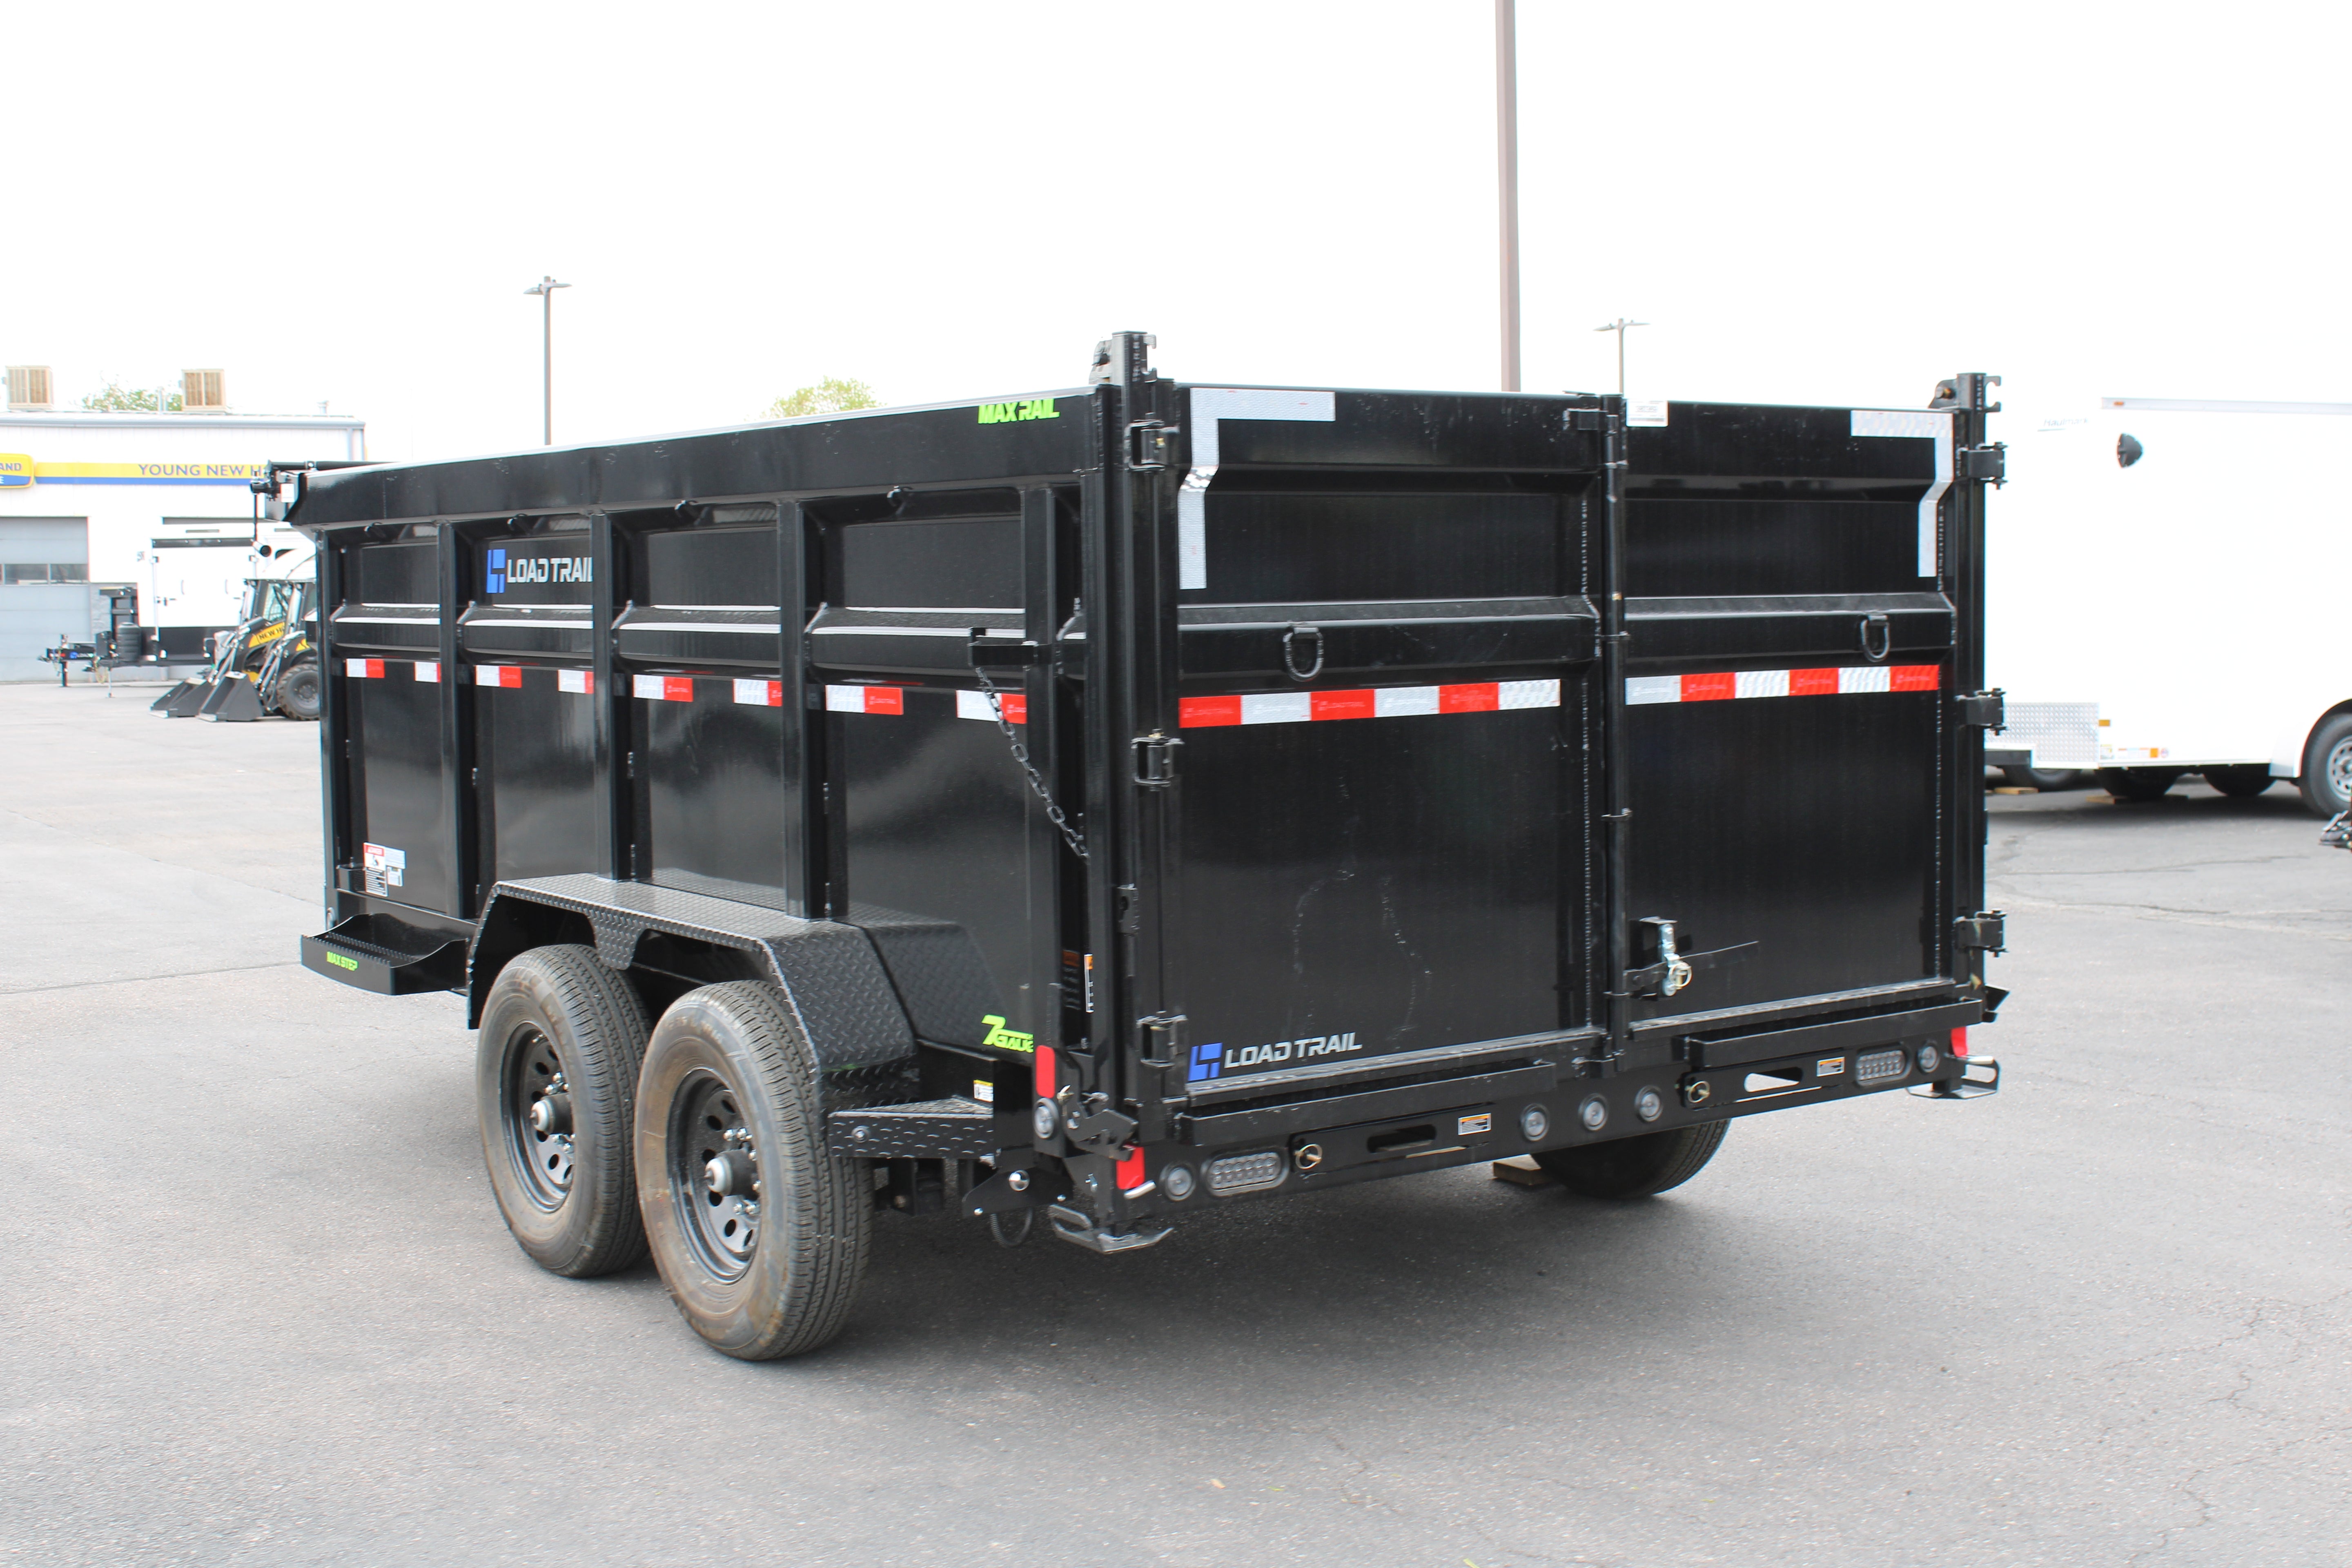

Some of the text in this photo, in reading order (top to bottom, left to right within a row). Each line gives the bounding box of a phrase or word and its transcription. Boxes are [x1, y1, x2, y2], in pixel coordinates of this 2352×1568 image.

[978, 398, 1060, 424] MAX RAIL
[138, 464, 200, 476] YOUNG
[207, 465, 244, 476] NEW
[1224, 1032, 1363, 1069] LOAD TRAIL
